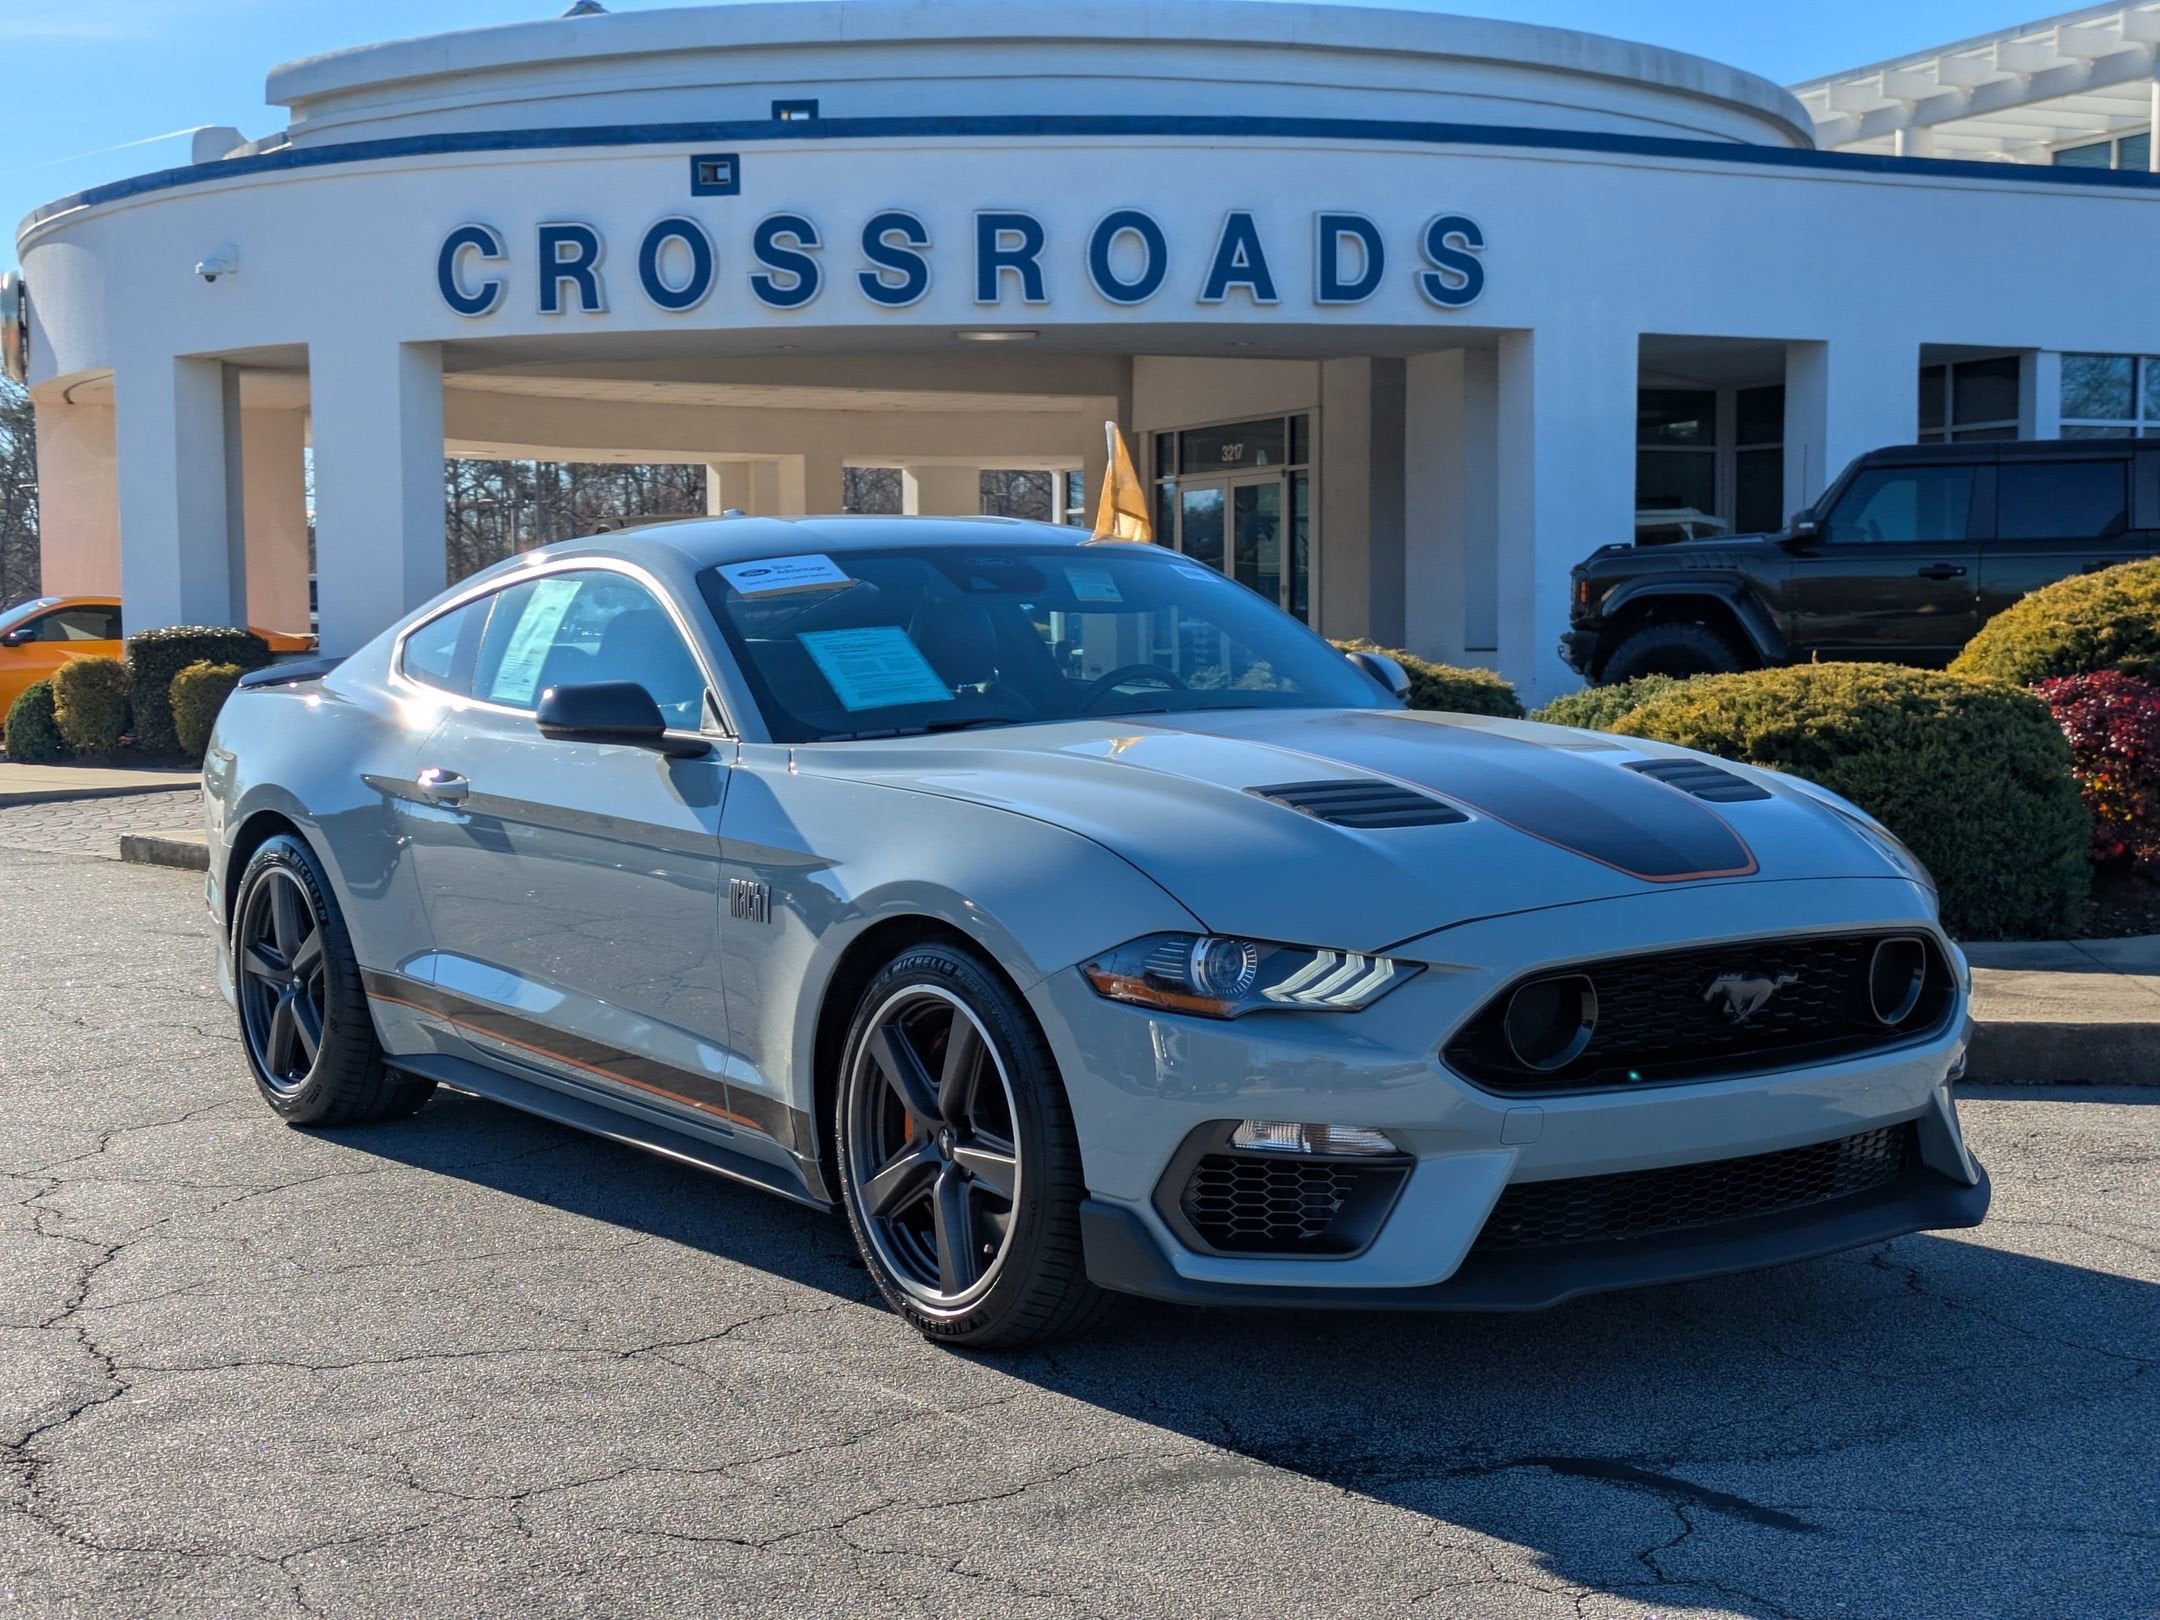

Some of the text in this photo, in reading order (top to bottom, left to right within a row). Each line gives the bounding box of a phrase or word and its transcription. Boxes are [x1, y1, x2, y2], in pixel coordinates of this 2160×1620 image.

[437, 208, 1486, 316] CROSSROADS
[1222, 443, 1244, 462] 3217
[776, 566, 826, 575] Advantage
[291, 852, 328, 921] MICHELIN
[892, 956, 955, 974] MICHELIN
